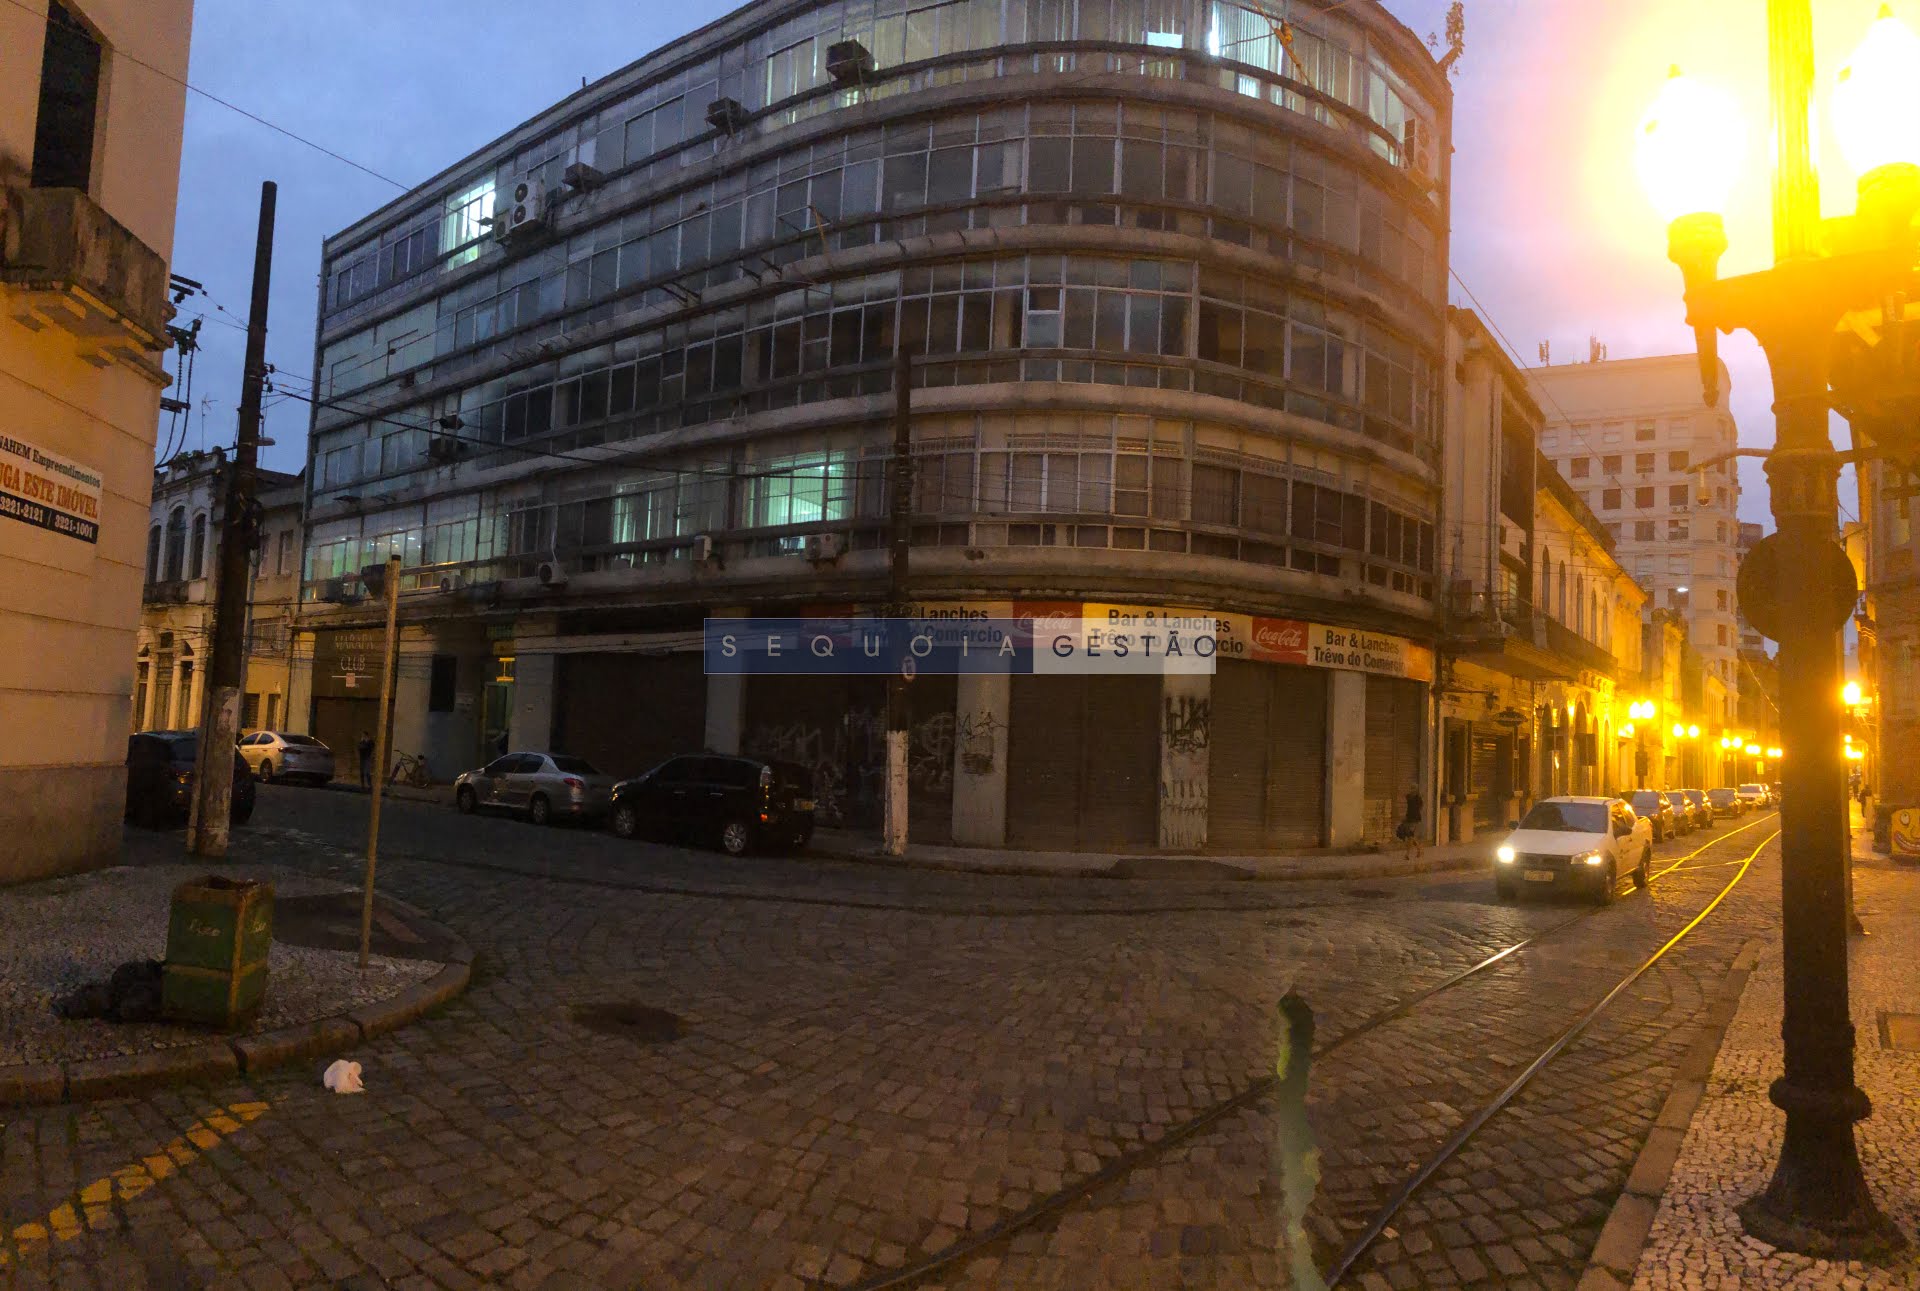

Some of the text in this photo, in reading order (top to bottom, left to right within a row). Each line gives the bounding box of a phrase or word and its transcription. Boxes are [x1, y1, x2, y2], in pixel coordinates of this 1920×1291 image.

[33, 449, 100, 488] Empreendimentos
[23, 471, 55, 503] ESTE
[57, 484, 98, 519] IMÓVEL
[0, 496, 43, 522] 3221-2121
[54, 514, 93, 539] 3221-1001
[920, 606, 988, 623] Lanches
[1108, 609, 1230, 633] Bar & Lanches
[1326, 630, 1400, 656] Bar & Lanches
[340, 654, 366, 671] CLUB
[1313, 646, 1344, 665] Trêvo
[1347, 651, 1361, 666] do
